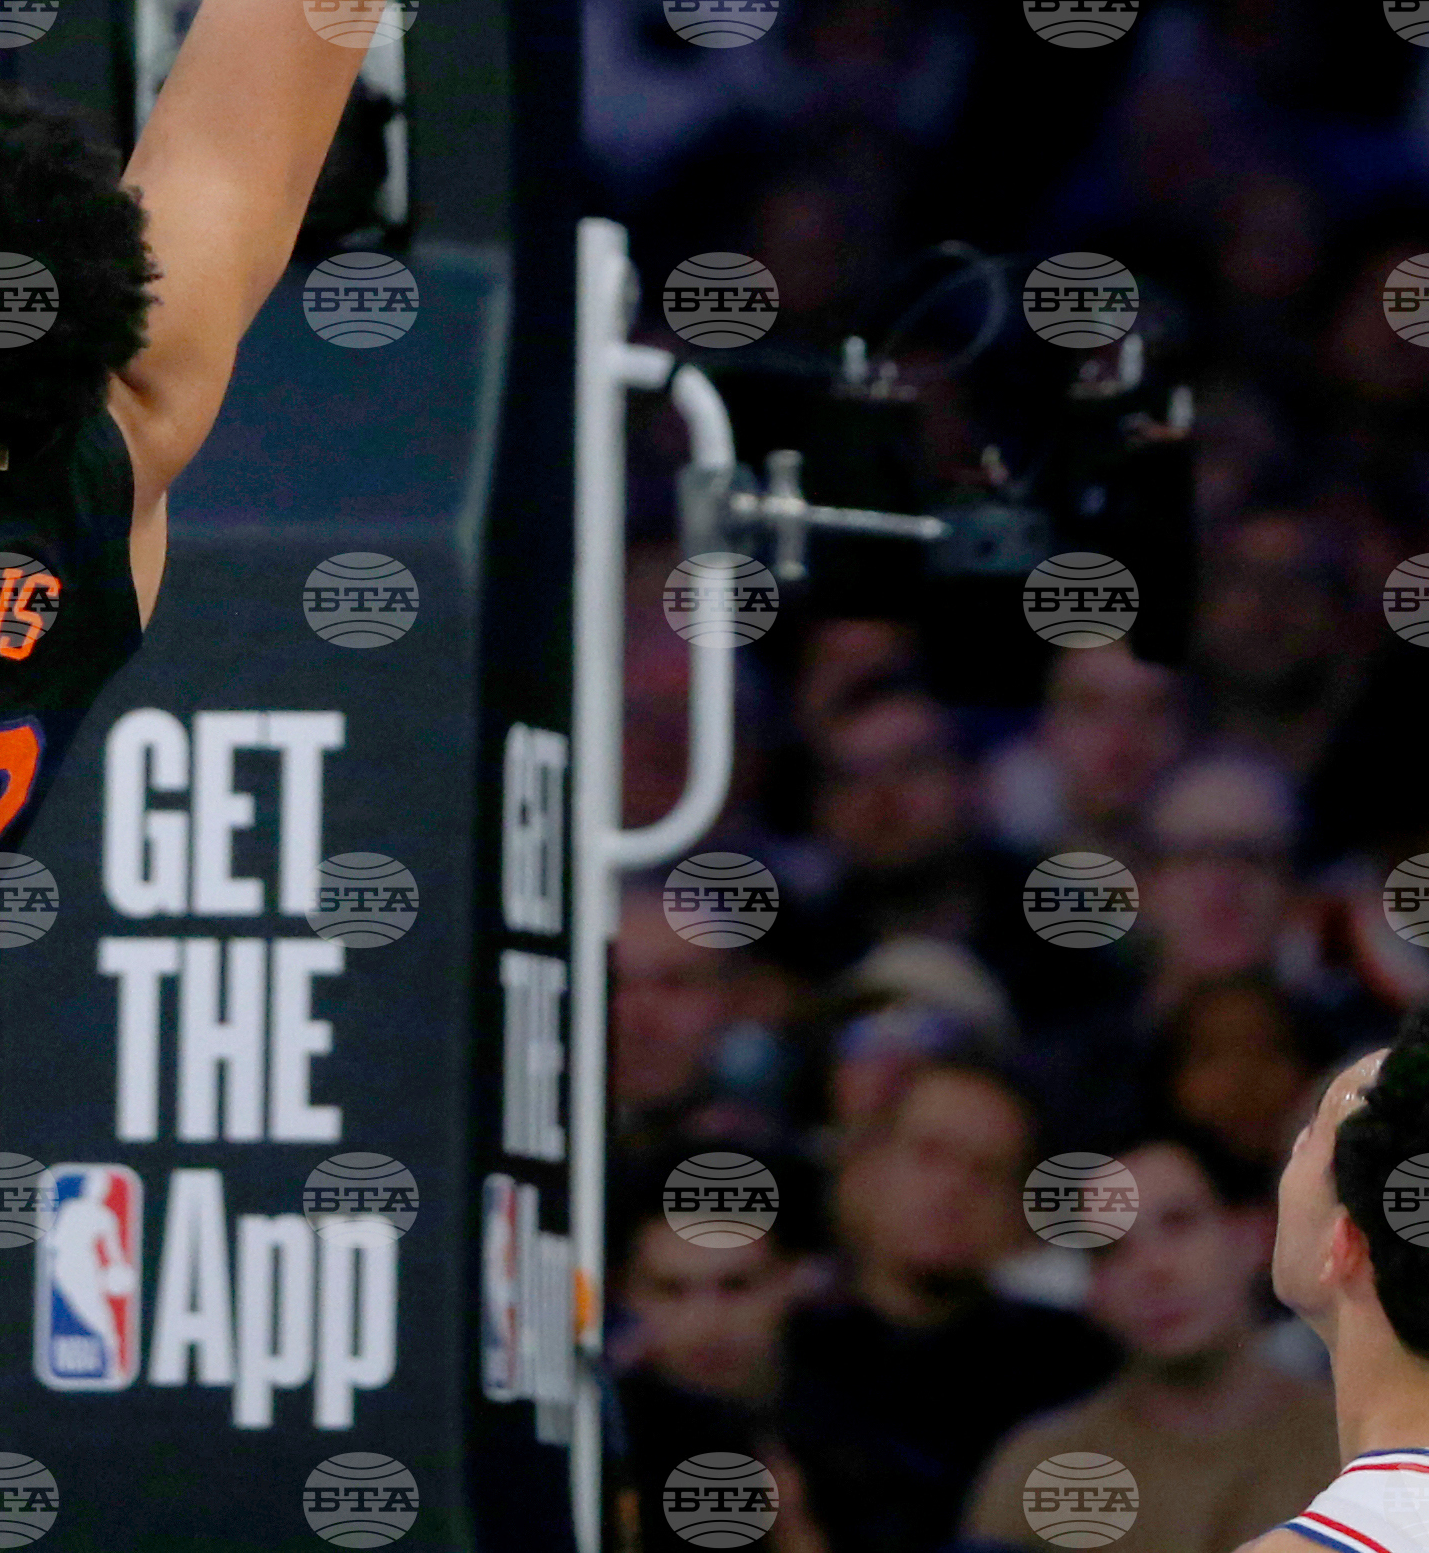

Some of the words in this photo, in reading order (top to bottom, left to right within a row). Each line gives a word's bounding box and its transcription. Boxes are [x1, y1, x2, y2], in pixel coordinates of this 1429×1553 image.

[102, 707, 346, 919] GET
[96, 936, 346, 1144] THE
[148, 1167, 399, 1432] App
